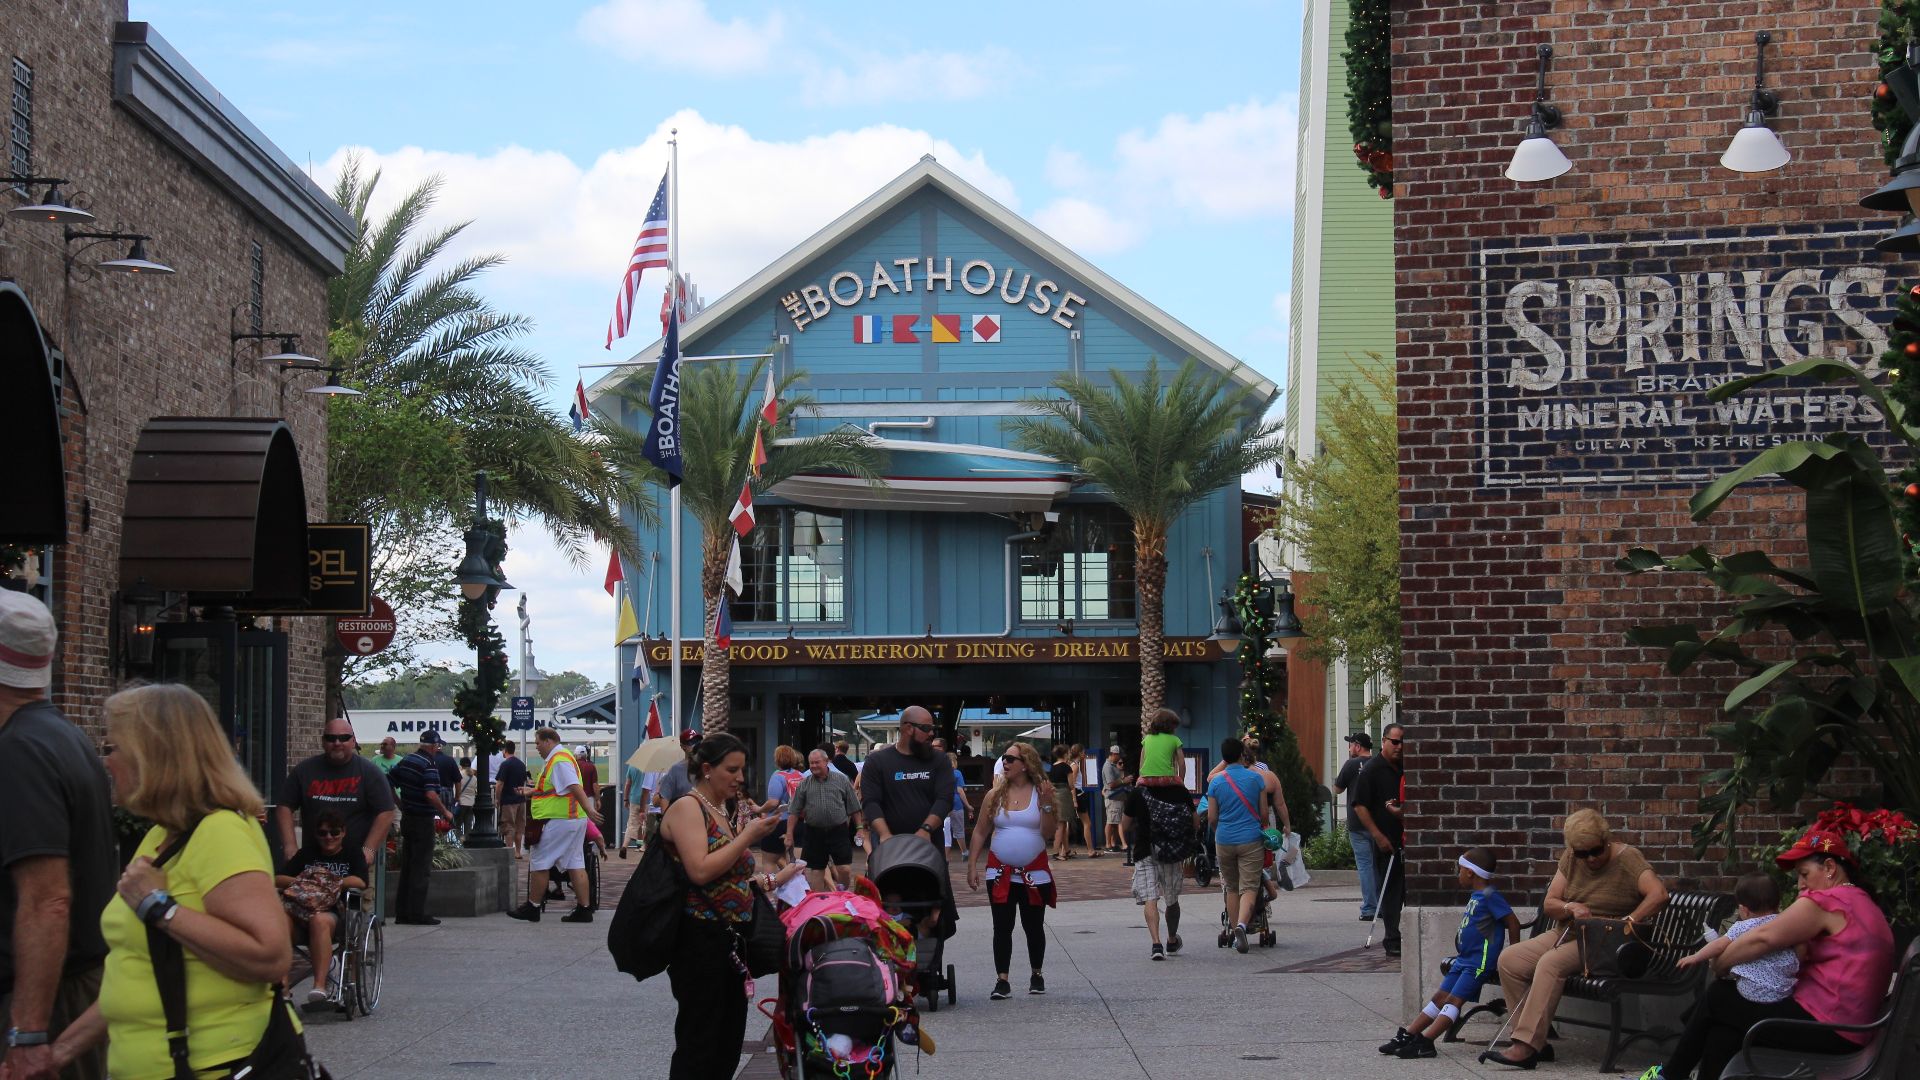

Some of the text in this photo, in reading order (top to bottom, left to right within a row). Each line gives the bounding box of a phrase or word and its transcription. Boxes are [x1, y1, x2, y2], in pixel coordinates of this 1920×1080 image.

[781, 257, 1087, 332] THE BOATHOUSE
[1503, 266, 1892, 392] SPRINGS
[657, 359, 680, 450] BOATHO
[1517, 395, 1887, 431] MINERAL WATERS
[1575, 438, 1647, 451] CLEAR
[1694, 433, 1824, 447] REFRESHIN
[308, 550, 358, 575] PEL
[338, 621, 394, 631] RESTROOMS
[729, 645, 789, 660] FOOD
[805, 644, 948, 660] WATERFRONT
[956, 643, 1035, 659] DINING
[1053, 642, 1130, 658] DREAM
[387, 720, 461, 732] AMPHIC
